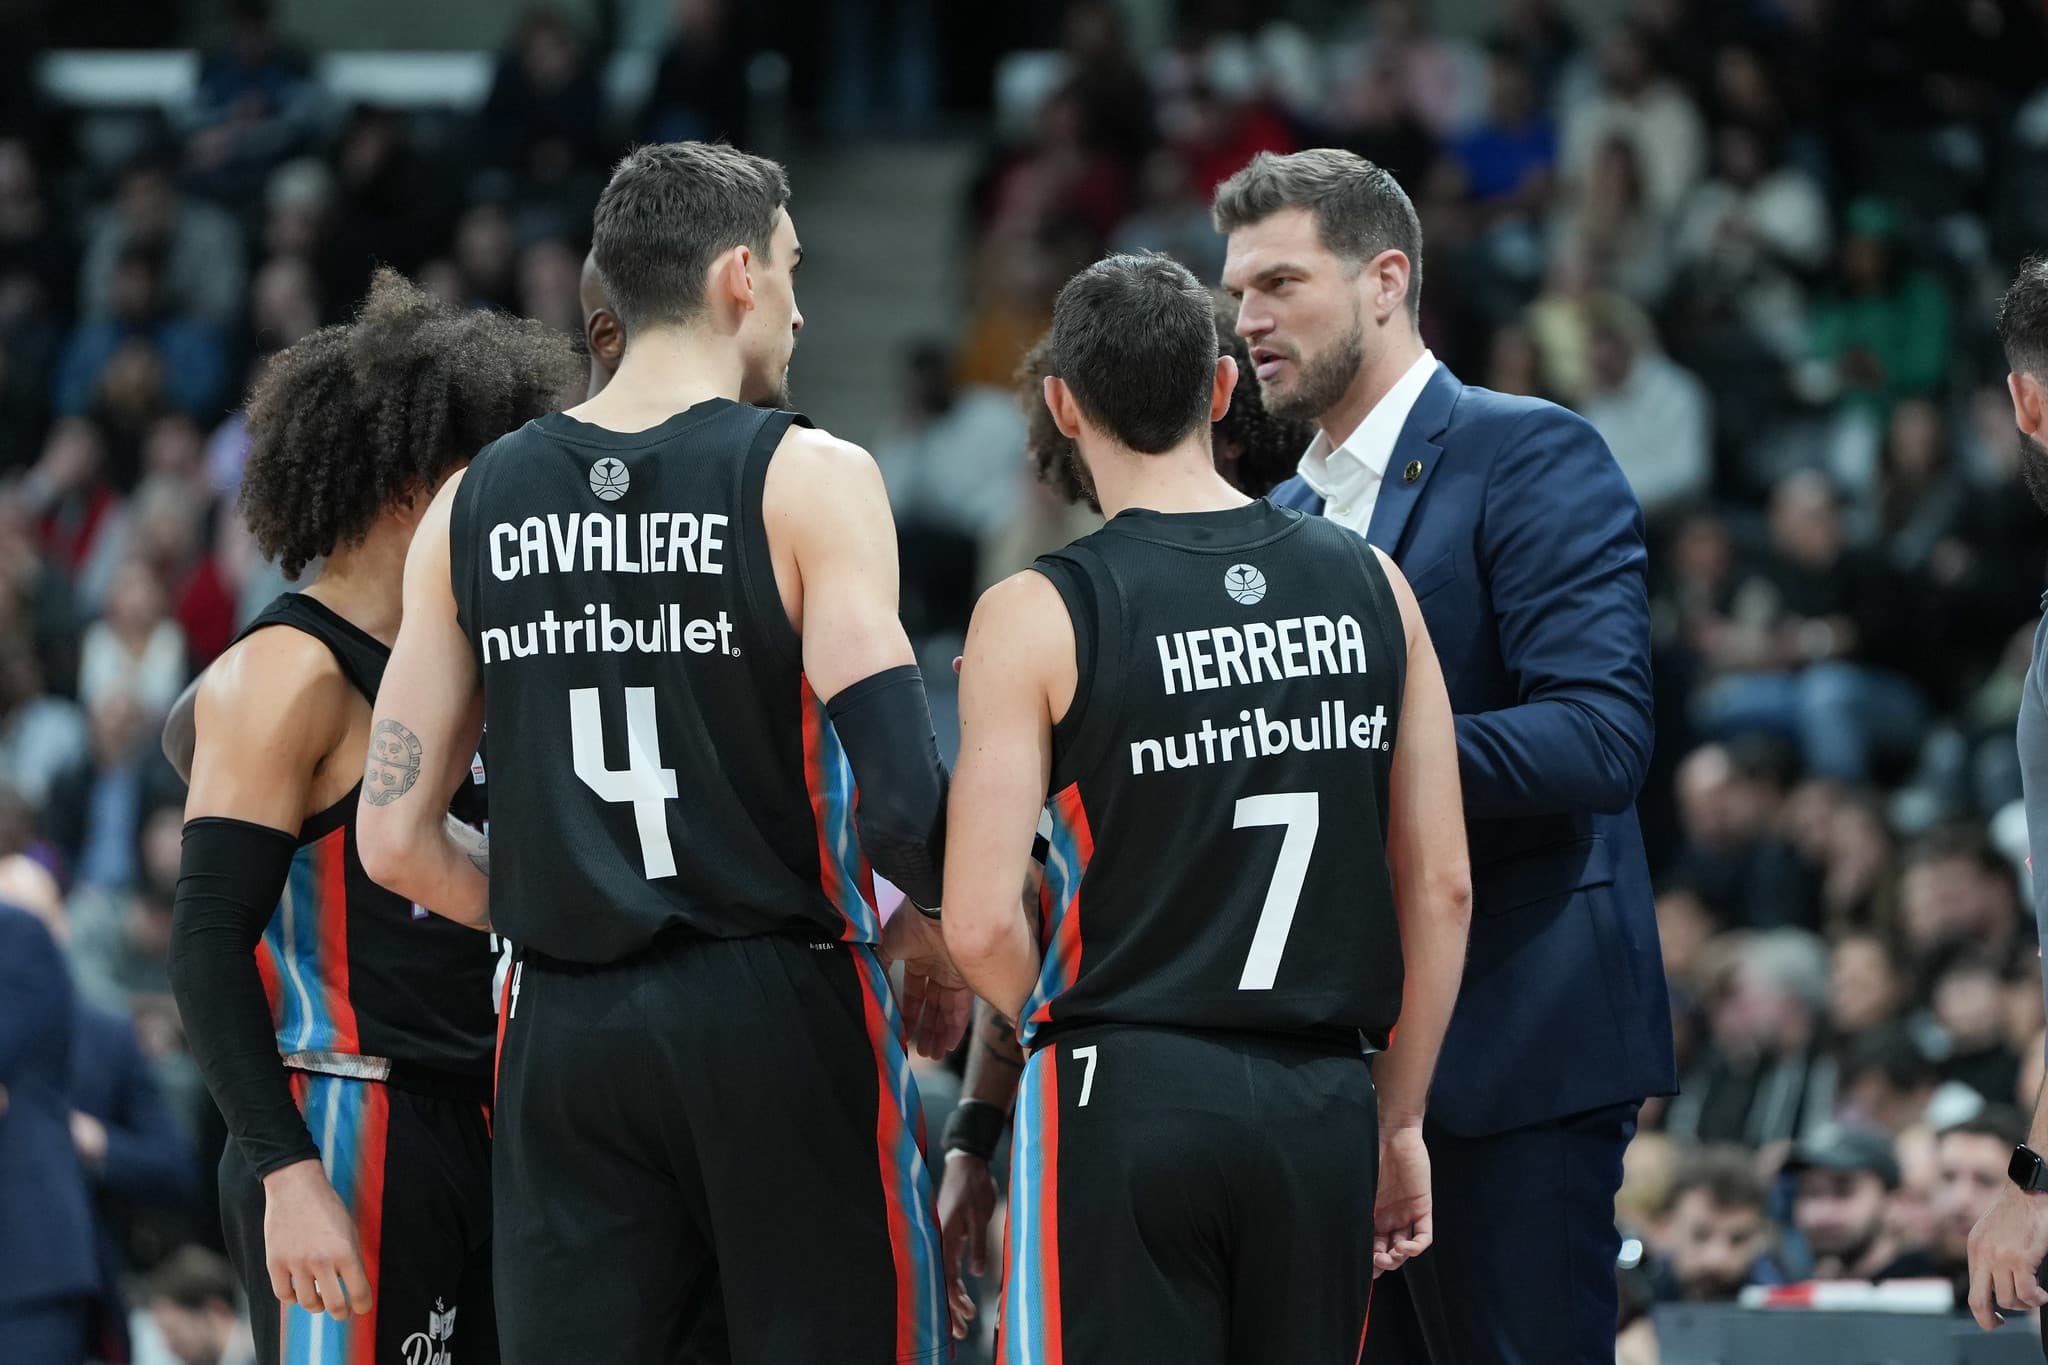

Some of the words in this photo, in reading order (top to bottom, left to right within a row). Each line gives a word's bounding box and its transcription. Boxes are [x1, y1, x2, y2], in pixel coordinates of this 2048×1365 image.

[489, 512, 729, 582] CAVALIERE
[1155, 614, 1367, 695] HERRERA
[569, 686, 679, 880] 4
[1232, 791, 1320, 990] 7
[1072, 1045, 1098, 1107] 7
